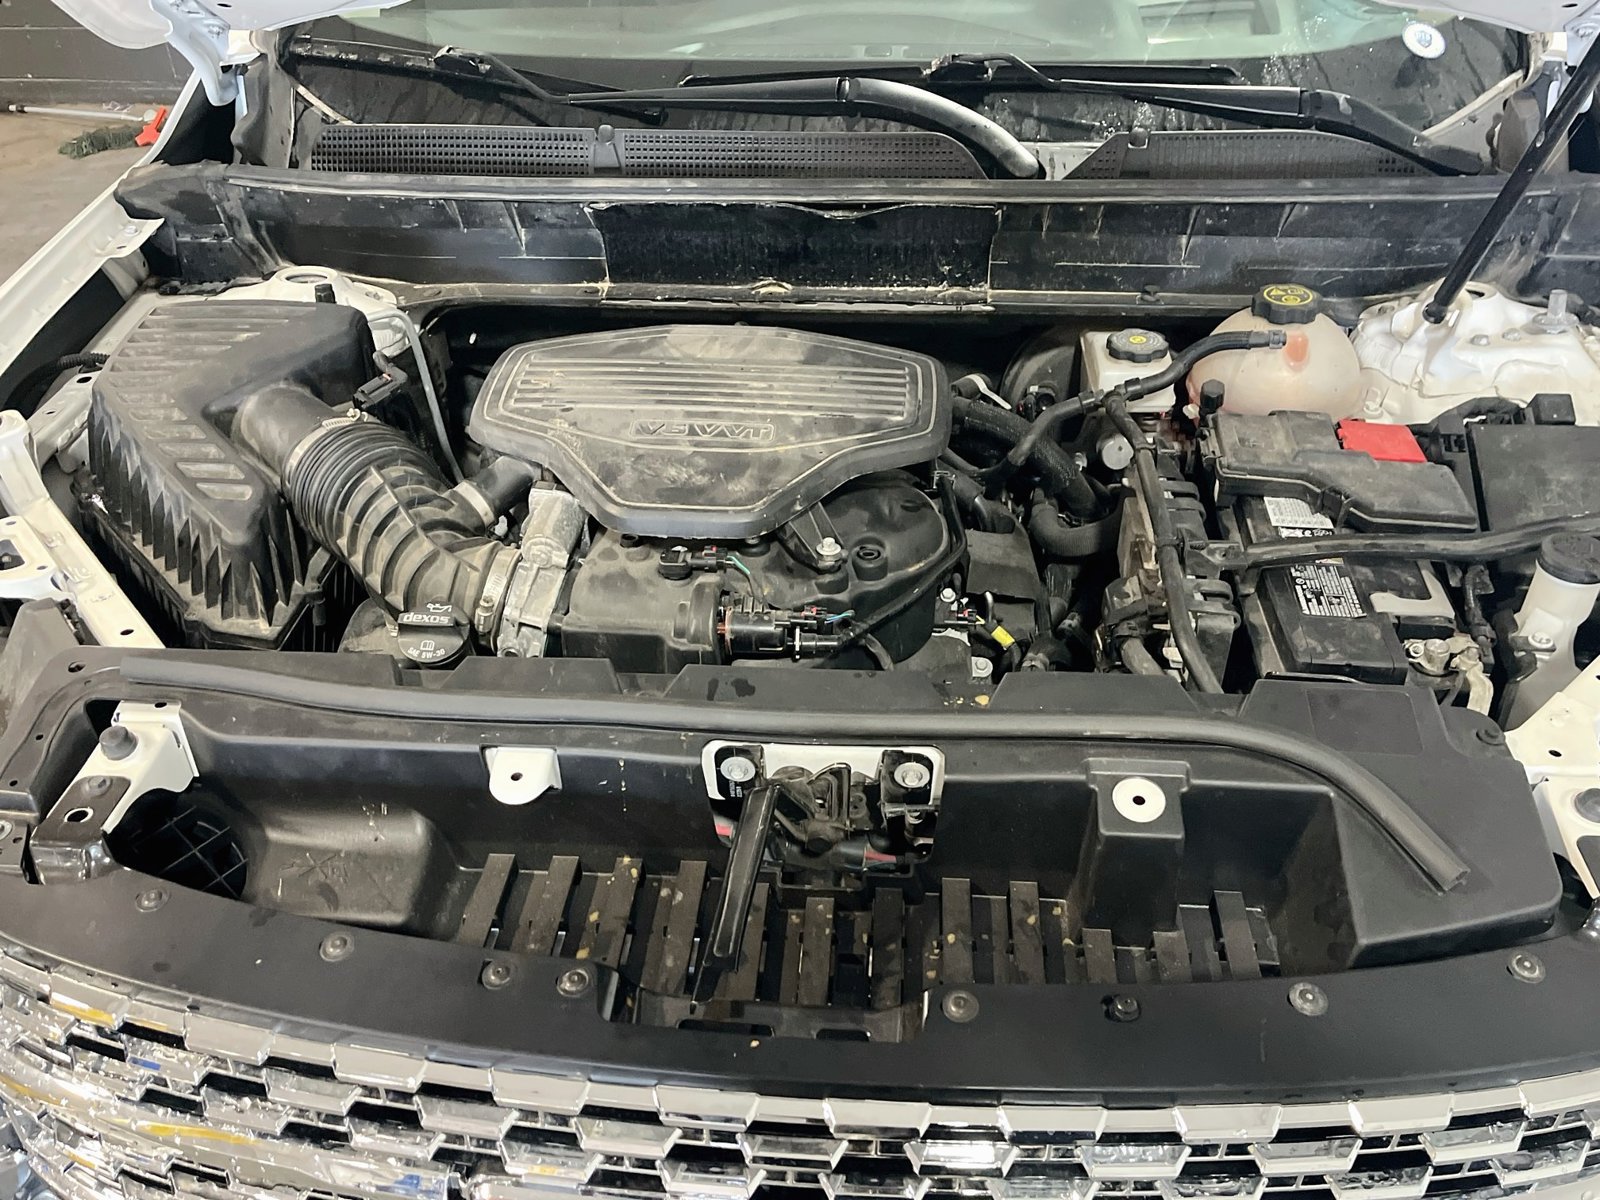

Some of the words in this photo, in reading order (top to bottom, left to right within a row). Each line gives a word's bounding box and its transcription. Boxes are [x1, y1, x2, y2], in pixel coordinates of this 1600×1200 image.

[637, 422, 688, 436] V6
[693, 423, 770, 438] VVT
[403, 612, 450, 624] dexos
[407, 647, 420, 657] SAE
[421, 648, 445, 658] 5W-30
